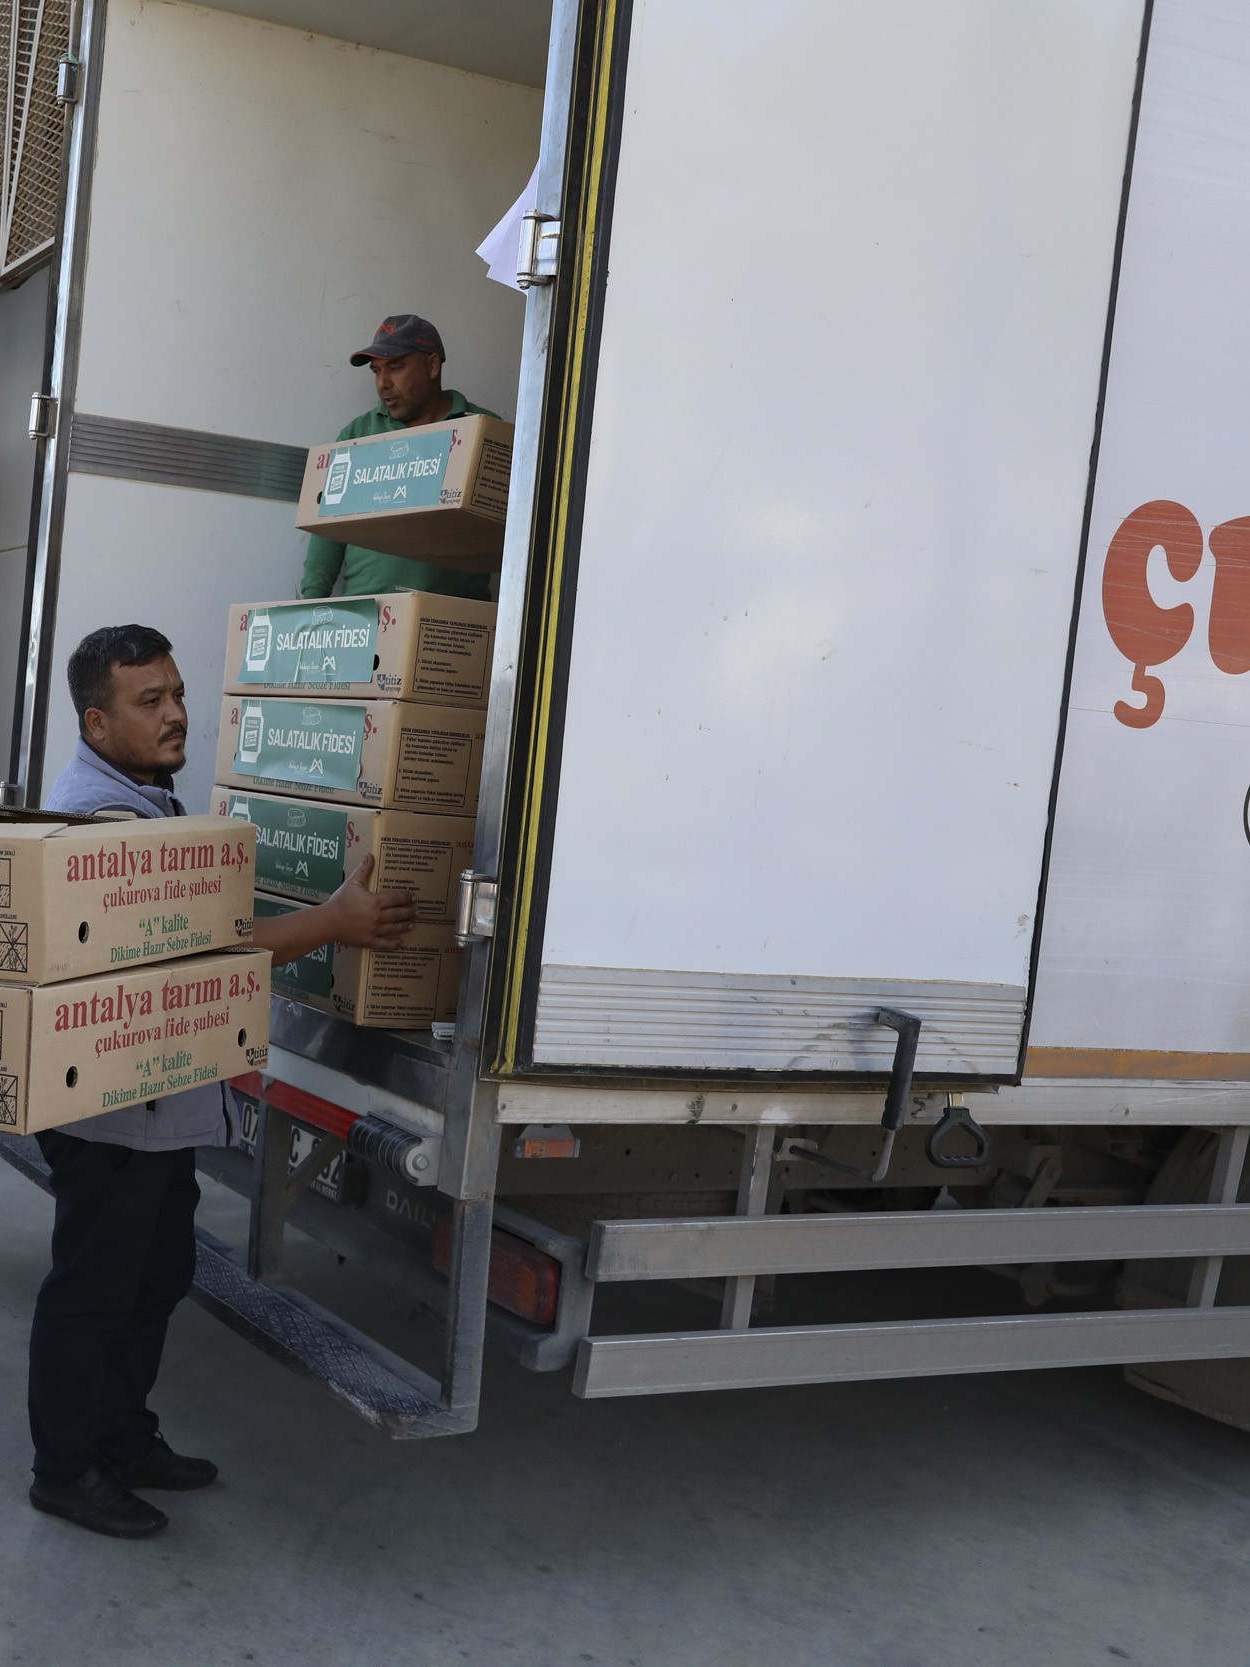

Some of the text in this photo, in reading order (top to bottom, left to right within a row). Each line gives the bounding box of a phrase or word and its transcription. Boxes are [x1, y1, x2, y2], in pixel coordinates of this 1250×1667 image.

[354, 453, 442, 485] SALATALIK FİDESİ
[276, 624, 370, 651] SALATALIK FİDESİ
[267, 728, 356, 754] SALATALIK FİDESİ
[256, 828, 306, 853] SALATALIK
[306, 832, 339, 860] FİDESİ
[66, 841, 152, 886] antalya
[160, 841, 214, 873] tarım
[220, 842, 249, 872] a.ş.
[103, 875, 222, 913] çukurova fide şubesi
[161, 913, 189, 933] kalite
[110, 930, 212, 963] Dikime Hazır Sebze Fidesi
[54, 984, 152, 1032] antalya
[161, 977, 222, 1012] tarım
[229, 969, 260, 1002] a.ş.
[95, 1006, 230, 1059] çukurova fide şubesi
[162, 1051, 192, 1072] kalite
[102, 1063, 218, 1108] Dikime Hazır Sebze Fidesi
